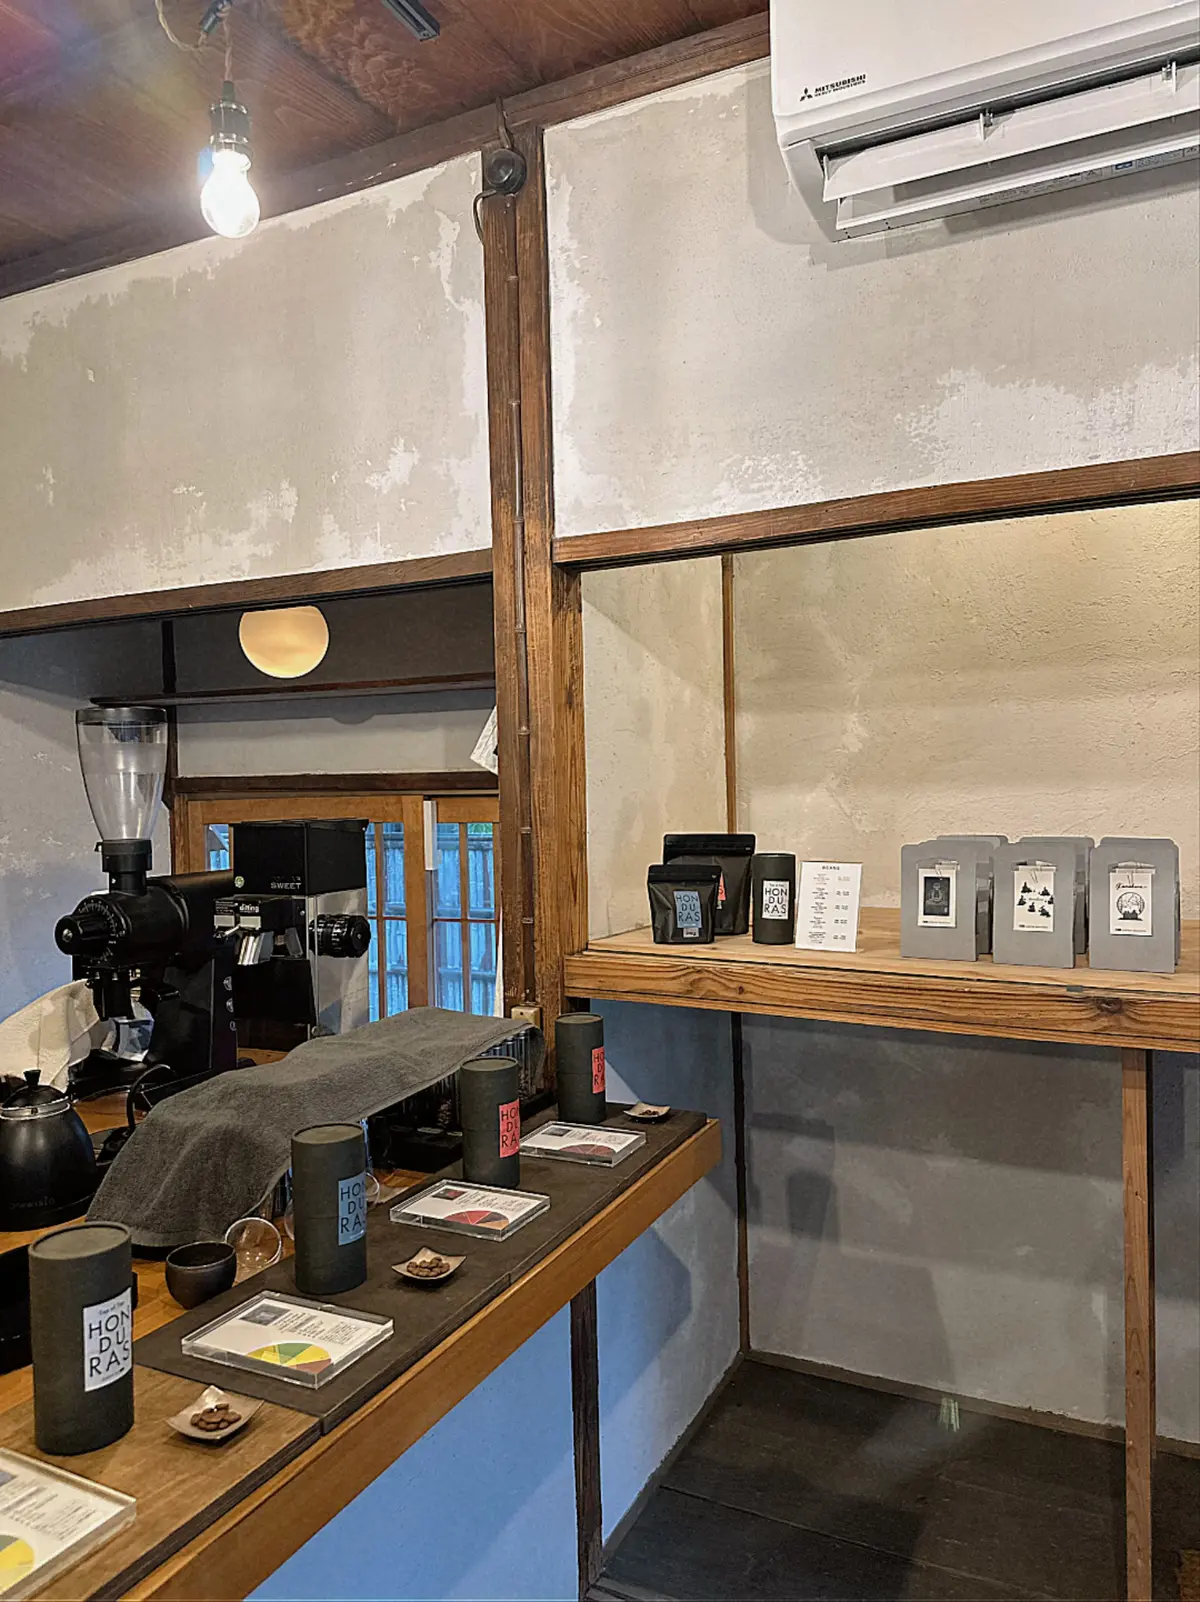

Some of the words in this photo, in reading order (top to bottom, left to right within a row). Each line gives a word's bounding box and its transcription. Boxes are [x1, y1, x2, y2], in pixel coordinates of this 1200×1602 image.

[814, 74, 866, 94] MITSUBISHI
[270, 882, 302, 890] SWEET
[764, 887, 788, 897] HON
[676, 894, 699, 903] HON
[768, 895, 784, 905] DU
[681, 903, 696, 912] DU
[764, 903, 787, 914] RAS
[678, 911, 700, 923] RAS
[501, 1131, 519, 1148] RA
[88, 1305, 130, 1340] HON
[99, 1327, 126, 1354] DU
[88, 1340, 131, 1378] RAS
